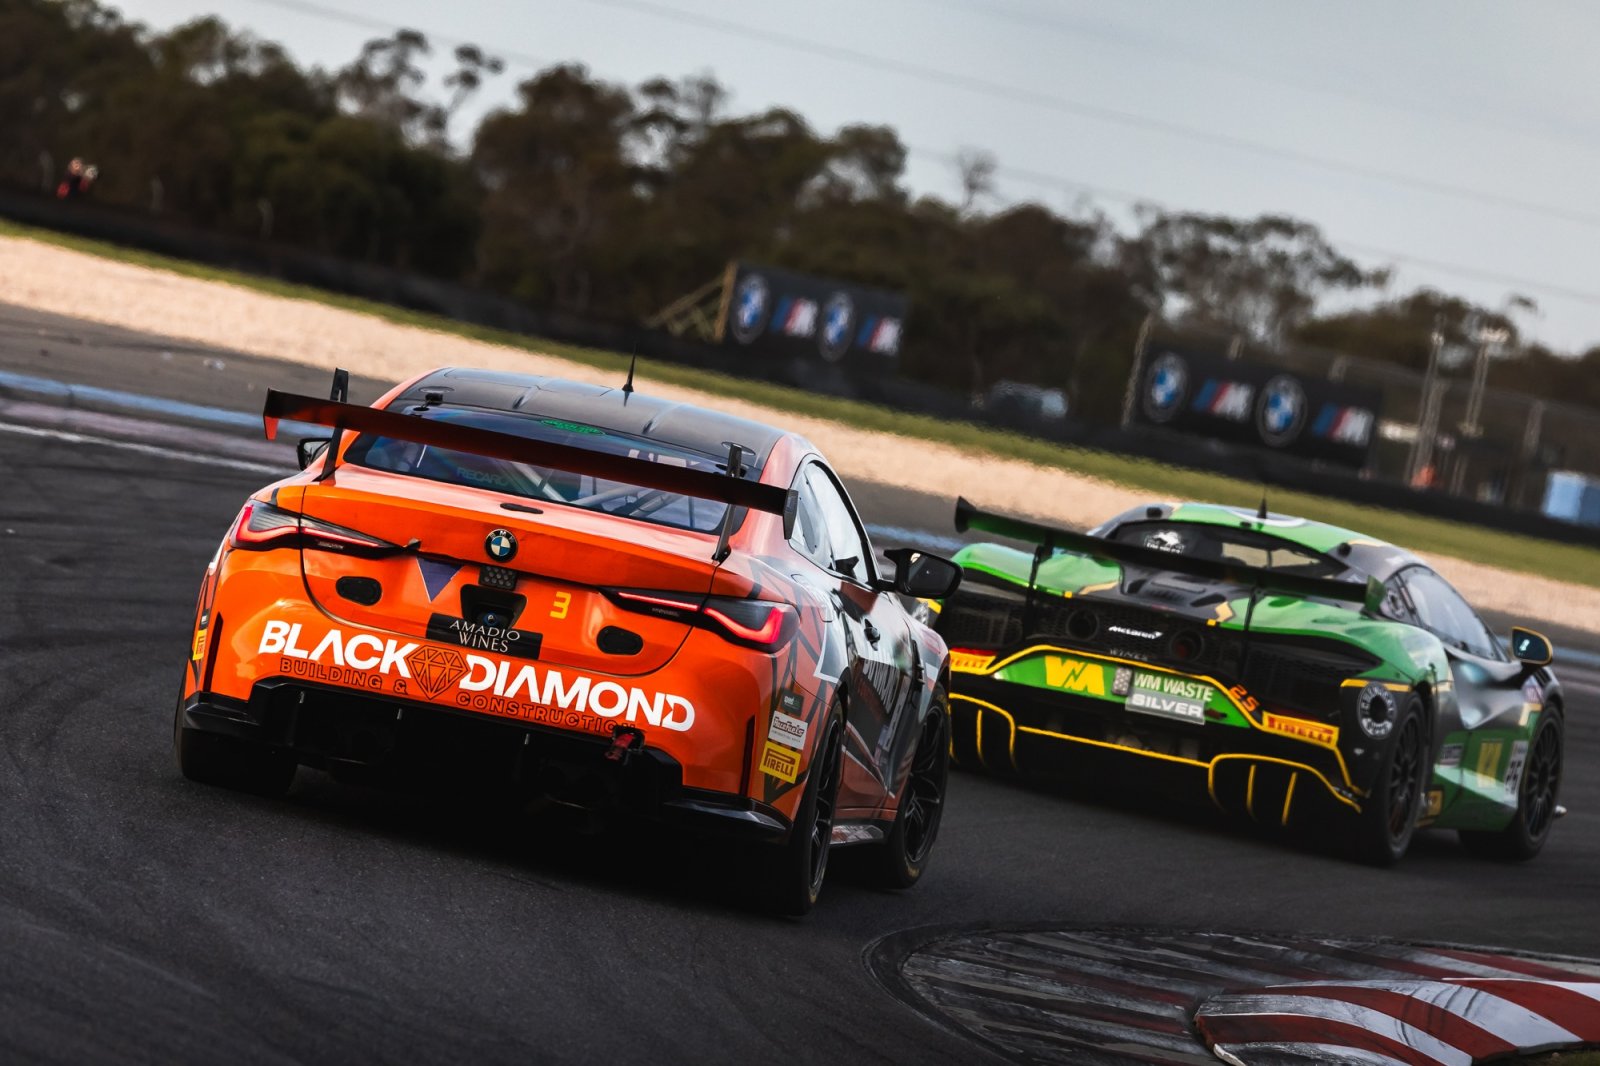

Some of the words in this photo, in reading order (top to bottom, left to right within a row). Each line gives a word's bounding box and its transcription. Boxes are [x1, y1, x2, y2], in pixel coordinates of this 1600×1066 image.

[549, 591, 572, 620] 3
[449, 620, 520, 641] AMADIO
[459, 631, 509, 653] WINES
[258, 620, 420, 679] BLACK
[459, 654, 696, 732] DIAMOND
[1133, 672, 1161, 690] WM
[1163, 679, 1214, 703] WASTE
[280, 657, 383, 690] BUILDING
[392, 678, 409, 695] &
[455, 691, 635, 735] CONSTRUCTIO
[1131, 693, 1204, 718] SILVER
[1229, 684, 1260, 713] 25
[763, 748, 796, 777] PIRELLI
